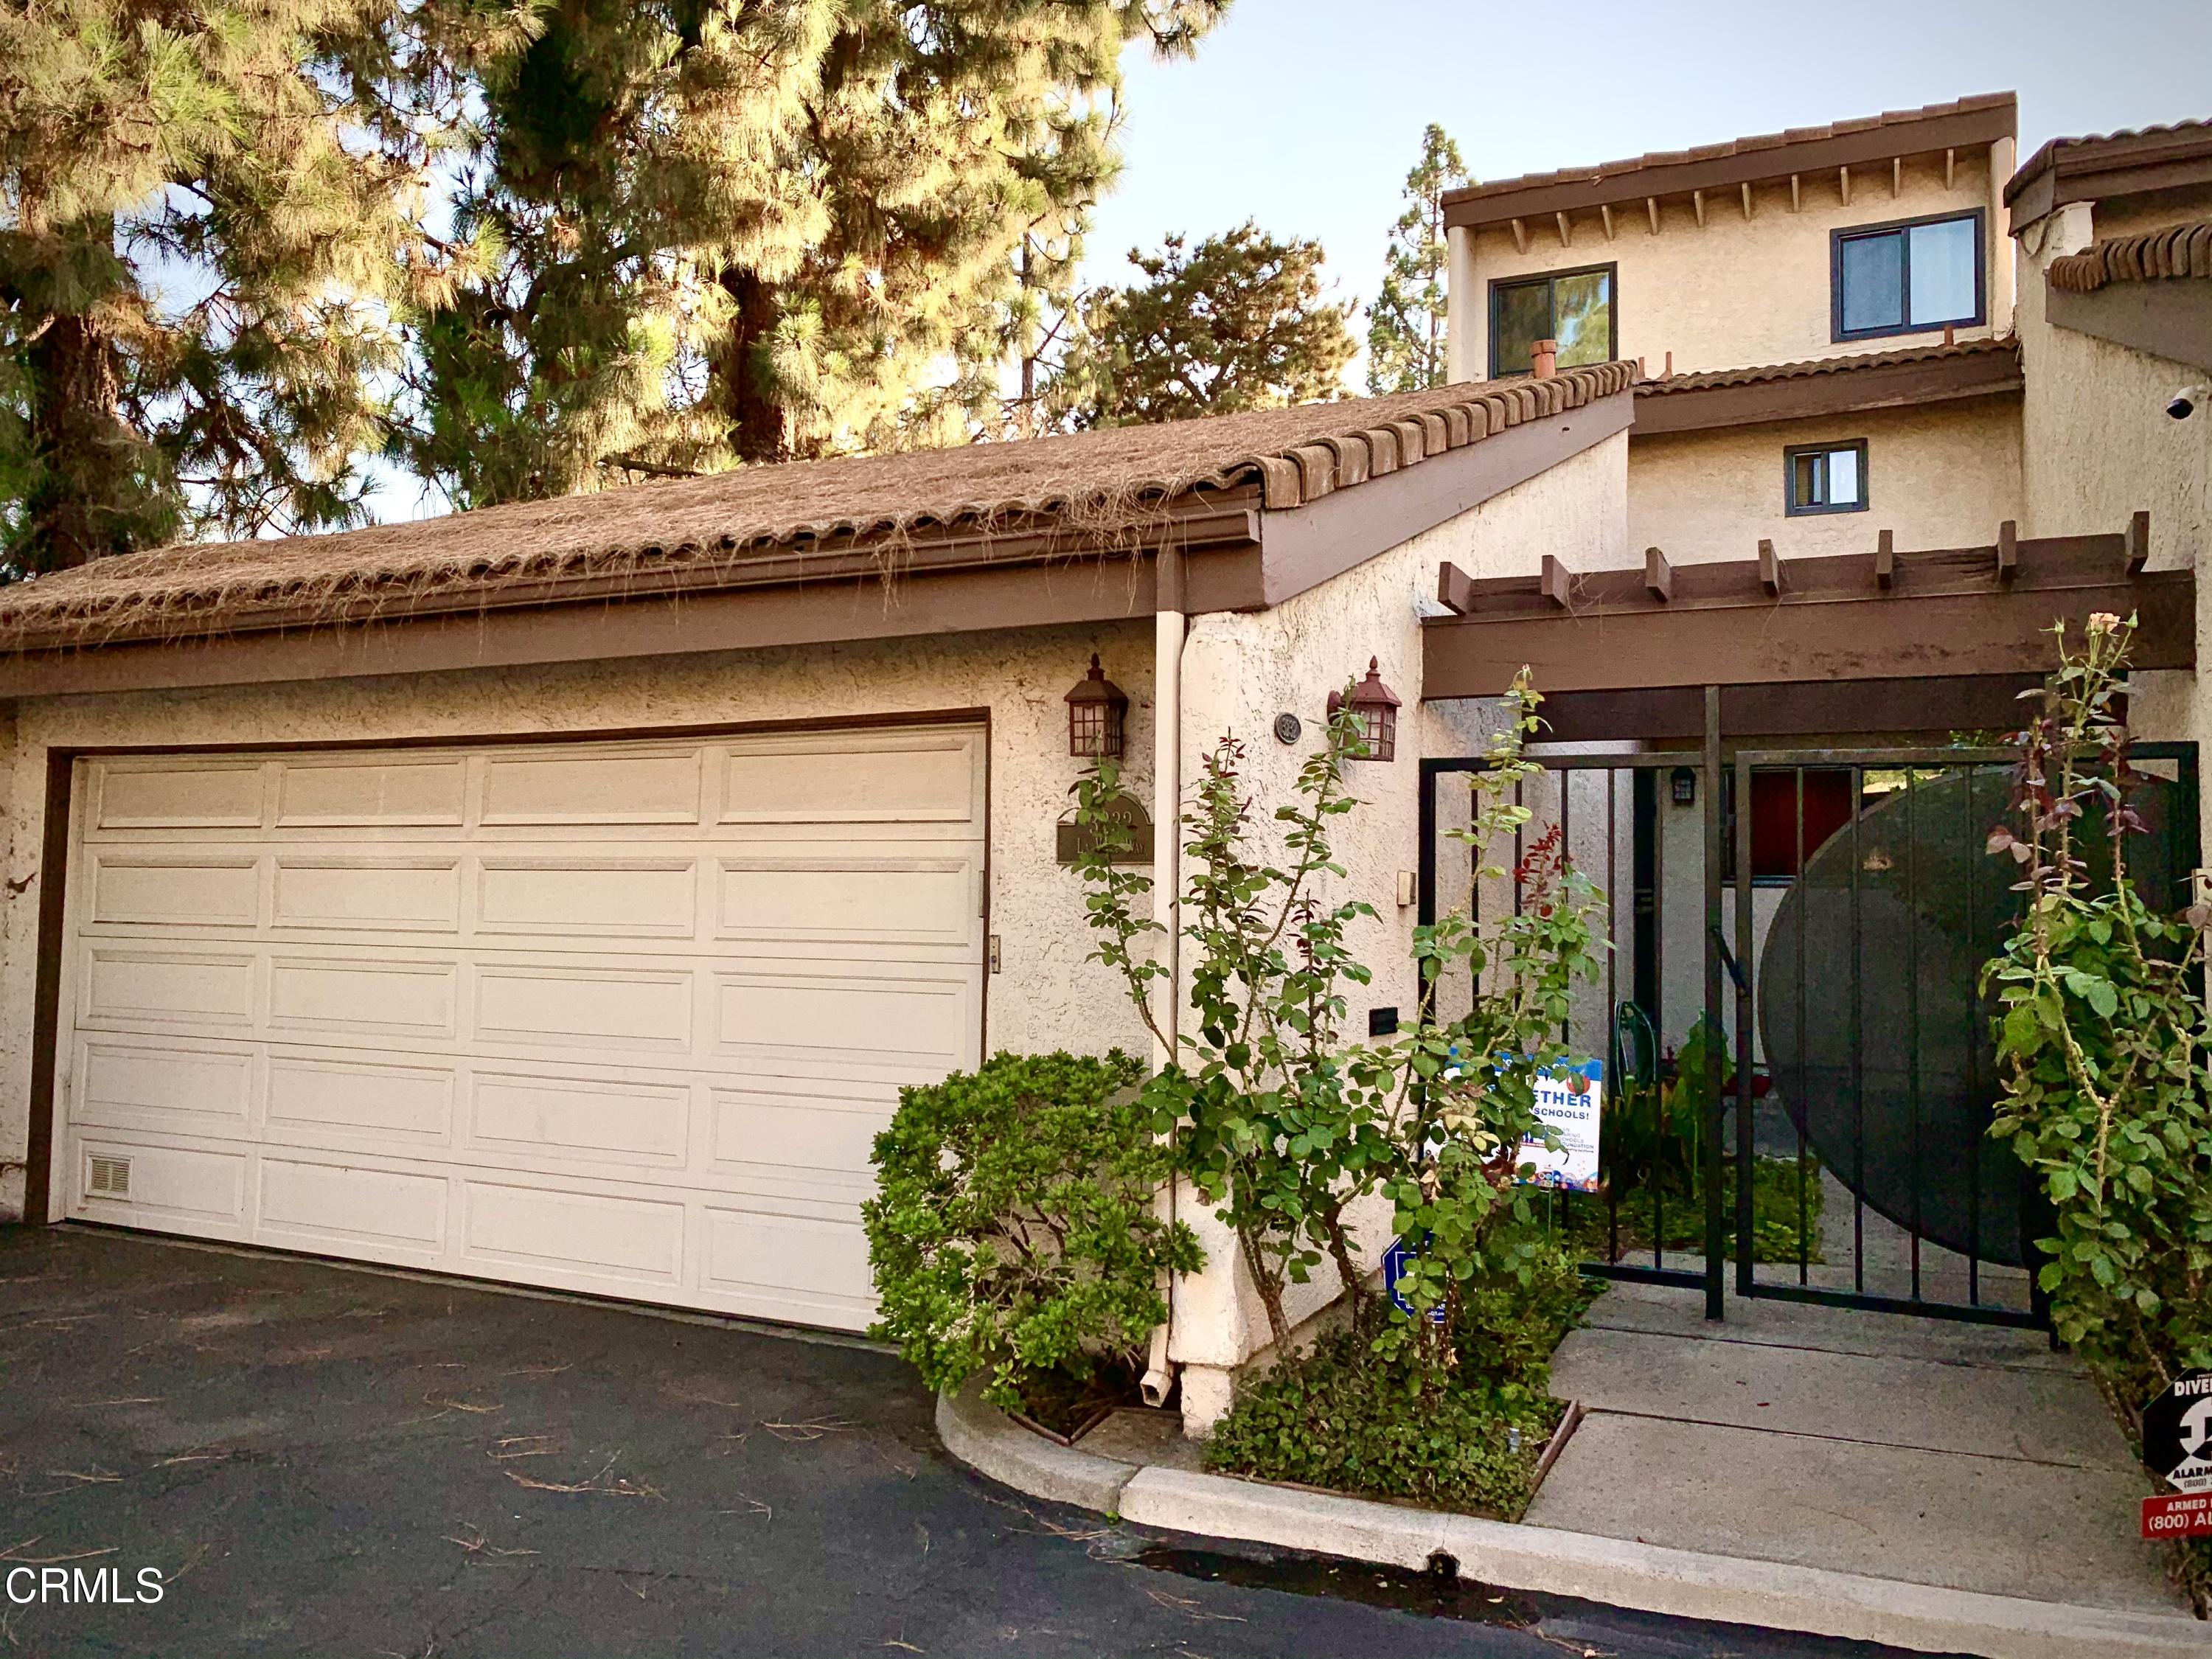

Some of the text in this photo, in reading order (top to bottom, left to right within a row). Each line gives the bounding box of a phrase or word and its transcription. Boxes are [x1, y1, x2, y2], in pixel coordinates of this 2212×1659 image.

[1534, 1107, 1589, 1120] SCHOOLS!
[2174, 1377, 2212, 1397] DIVE
[2167, 1499, 2207, 1512] ARMED
[2149, 1513, 2189, 1531] (800)
